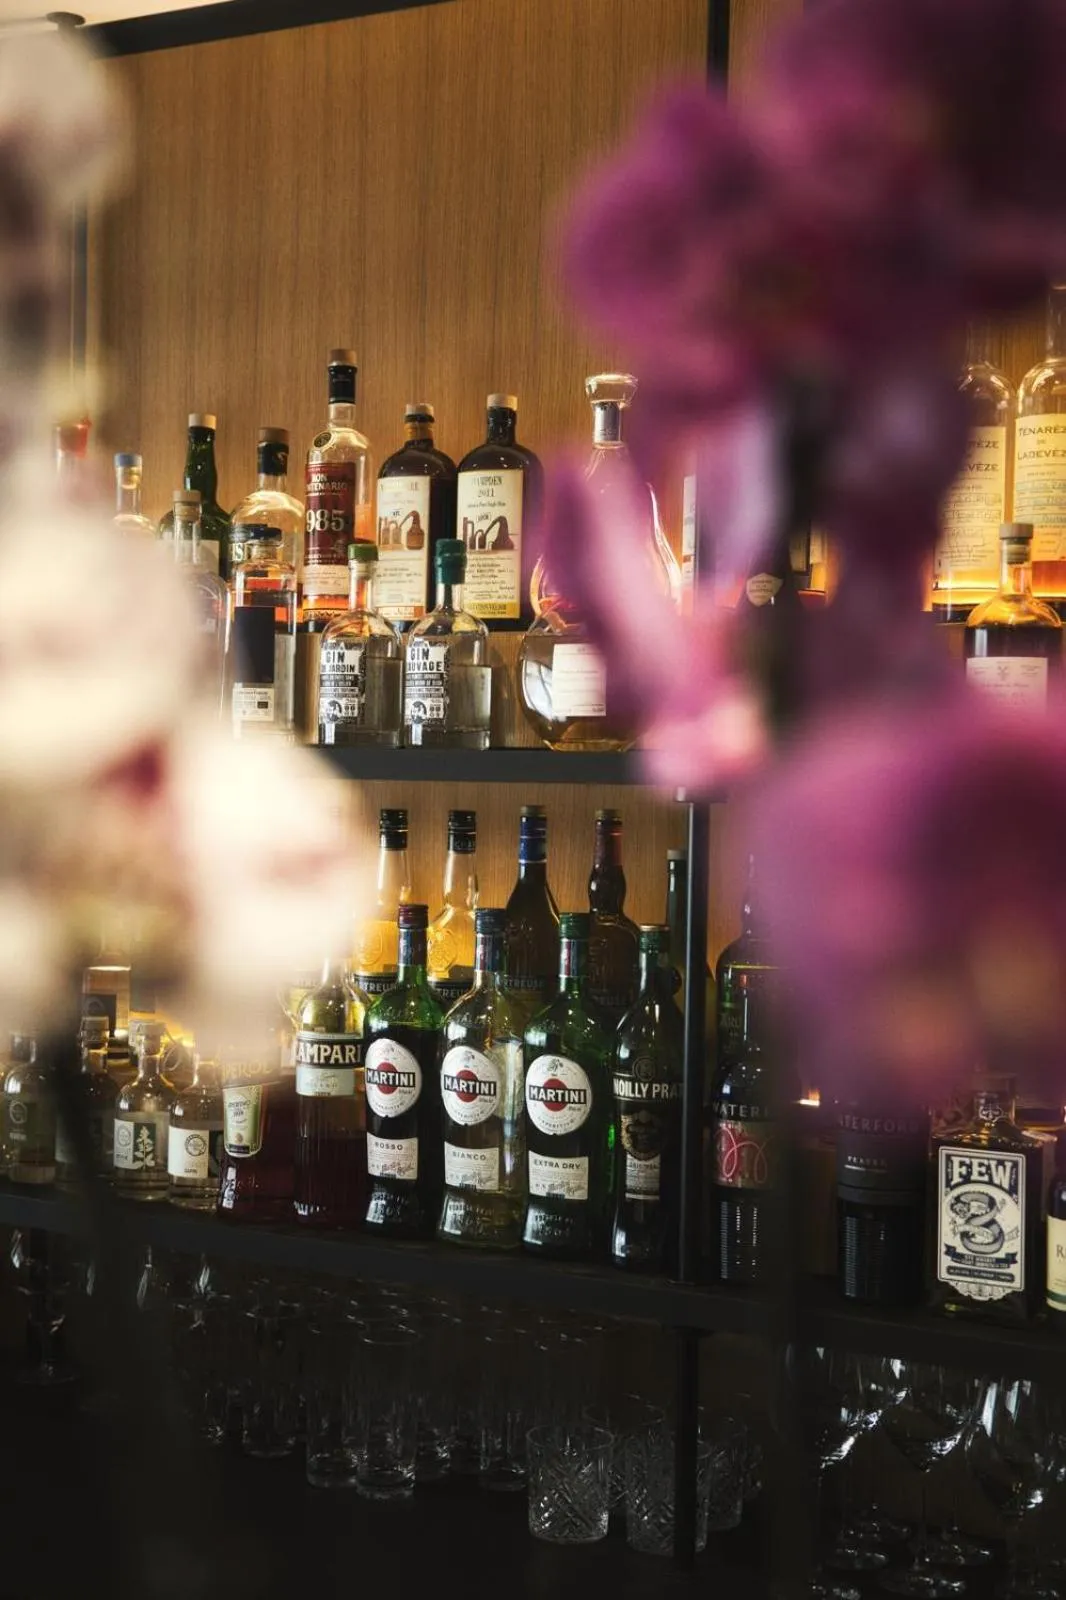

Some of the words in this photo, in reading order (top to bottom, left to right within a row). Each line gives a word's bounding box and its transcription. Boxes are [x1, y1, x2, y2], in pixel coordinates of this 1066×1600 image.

[326, 651, 345, 663] GIN
[410, 648, 430, 660] GIN
[367, 1068, 414, 1087] MARTINI
[444, 1076, 495, 1095] MARTINI
[613, 1078, 649, 1099] NOILLY
[530, 1085, 585, 1103] MARTINI
[374, 1141, 404, 1151] ROSSO
[452, 1151, 487, 1161] BIANCO
[534, 1159, 559, 1169] EXTRA
[562, 1162, 581, 1170] DRY
[950, 1156, 1013, 1190] FEW
